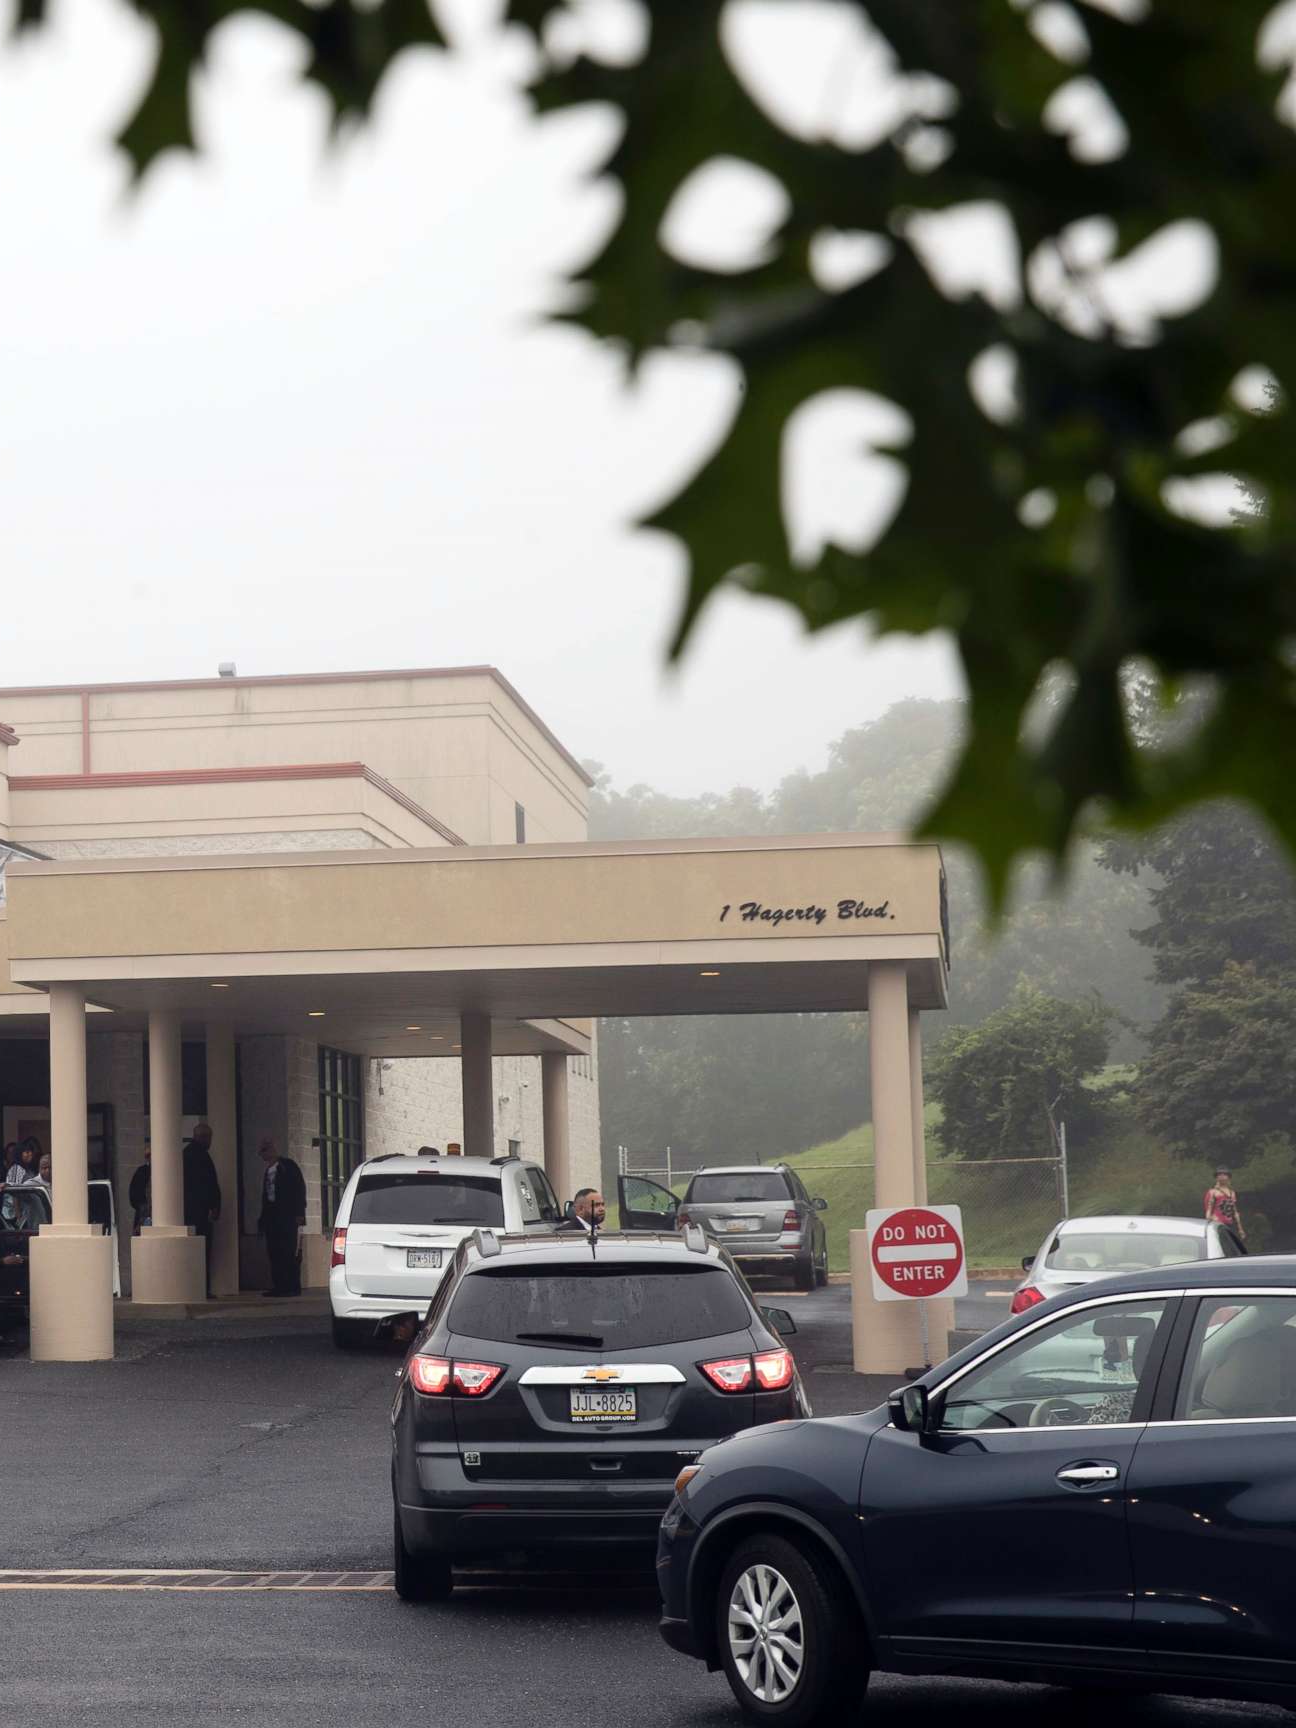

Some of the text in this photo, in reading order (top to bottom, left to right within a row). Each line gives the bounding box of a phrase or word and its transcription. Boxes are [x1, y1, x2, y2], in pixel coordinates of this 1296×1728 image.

[719, 899, 896, 926] 1 Hagerty Blvd.
[883, 1224, 947, 1241] DO NOT
[893, 1265, 945, 1282] ENTER
